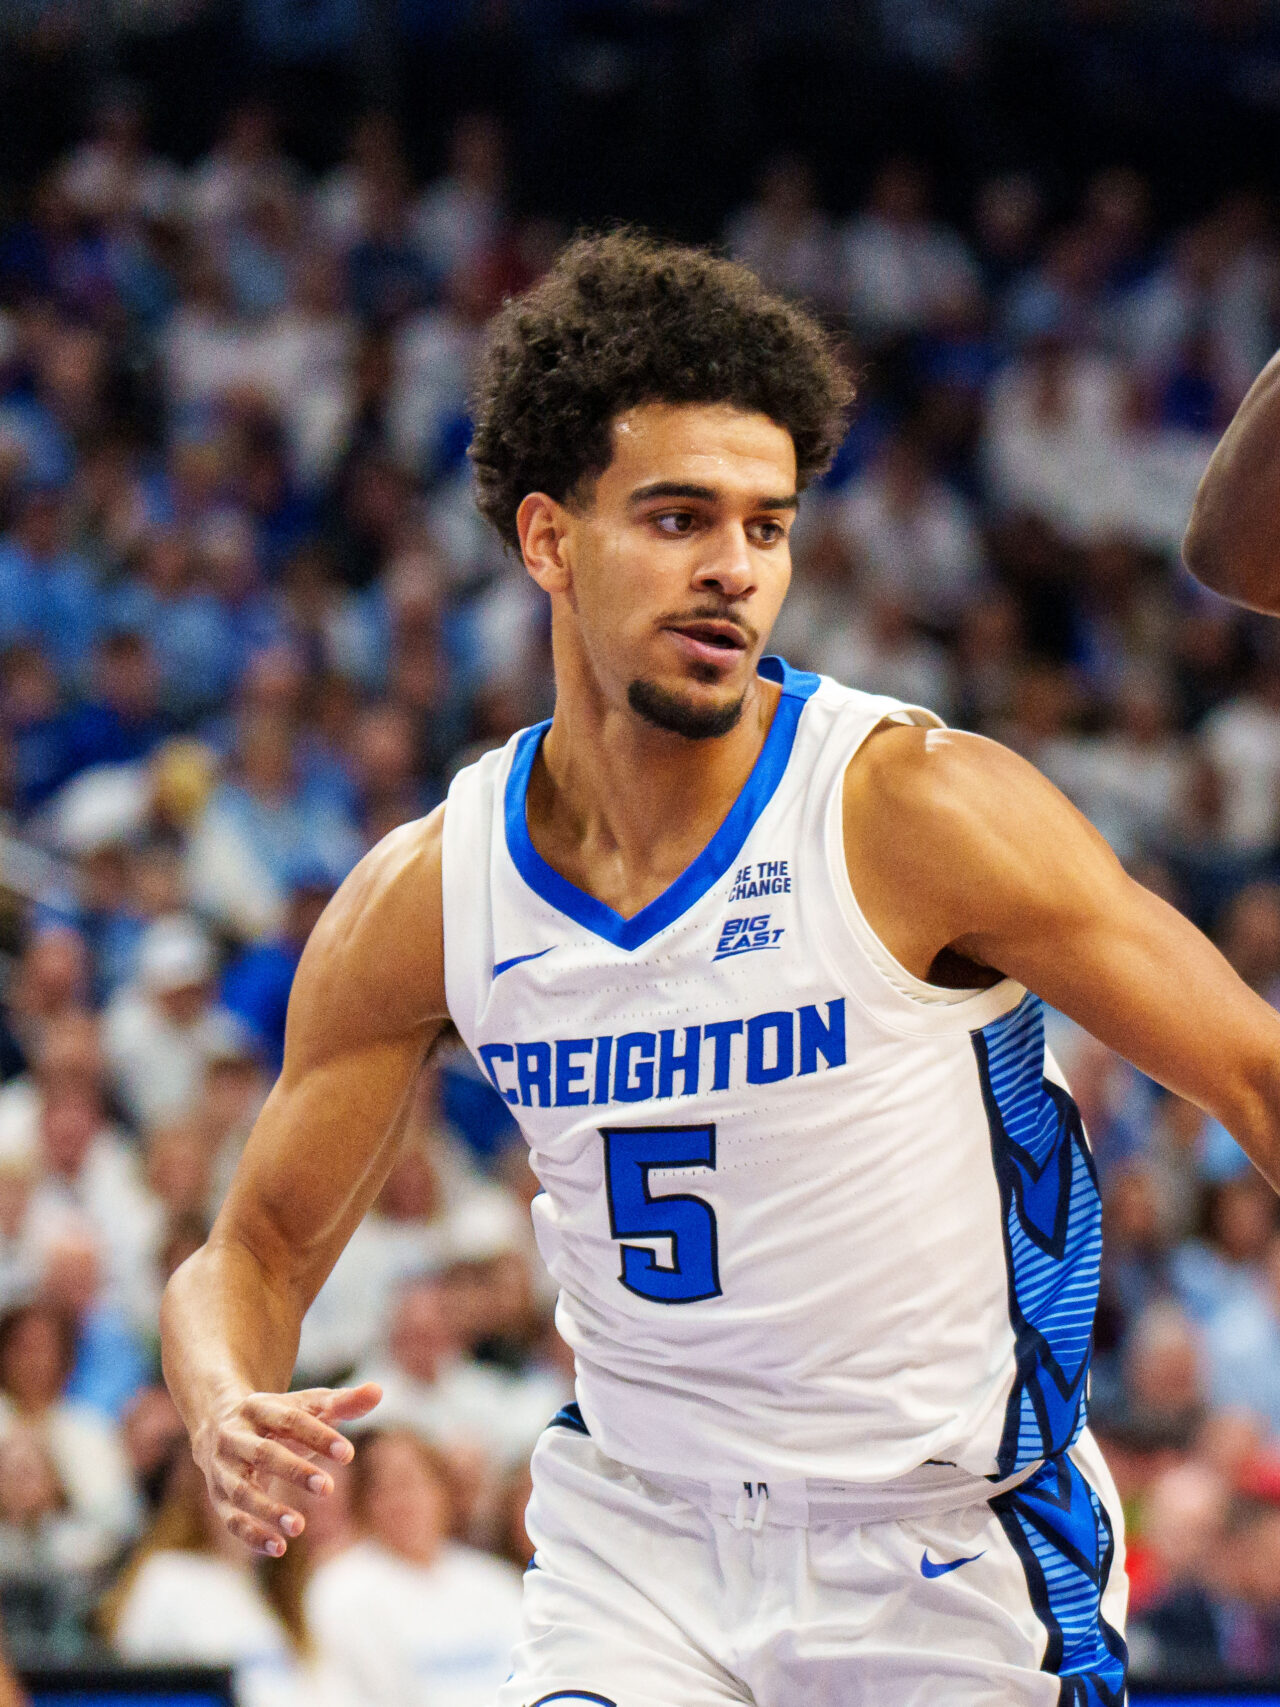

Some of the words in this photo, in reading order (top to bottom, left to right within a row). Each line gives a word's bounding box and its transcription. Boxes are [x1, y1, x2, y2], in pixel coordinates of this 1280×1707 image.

[757, 861, 788, 878] THE
[722, 914, 771, 936] BIG
[716, 929, 785, 953] EAST
[477, 997, 847, 1108] CREIGHTON
[597, 1122, 723, 1305] 5
